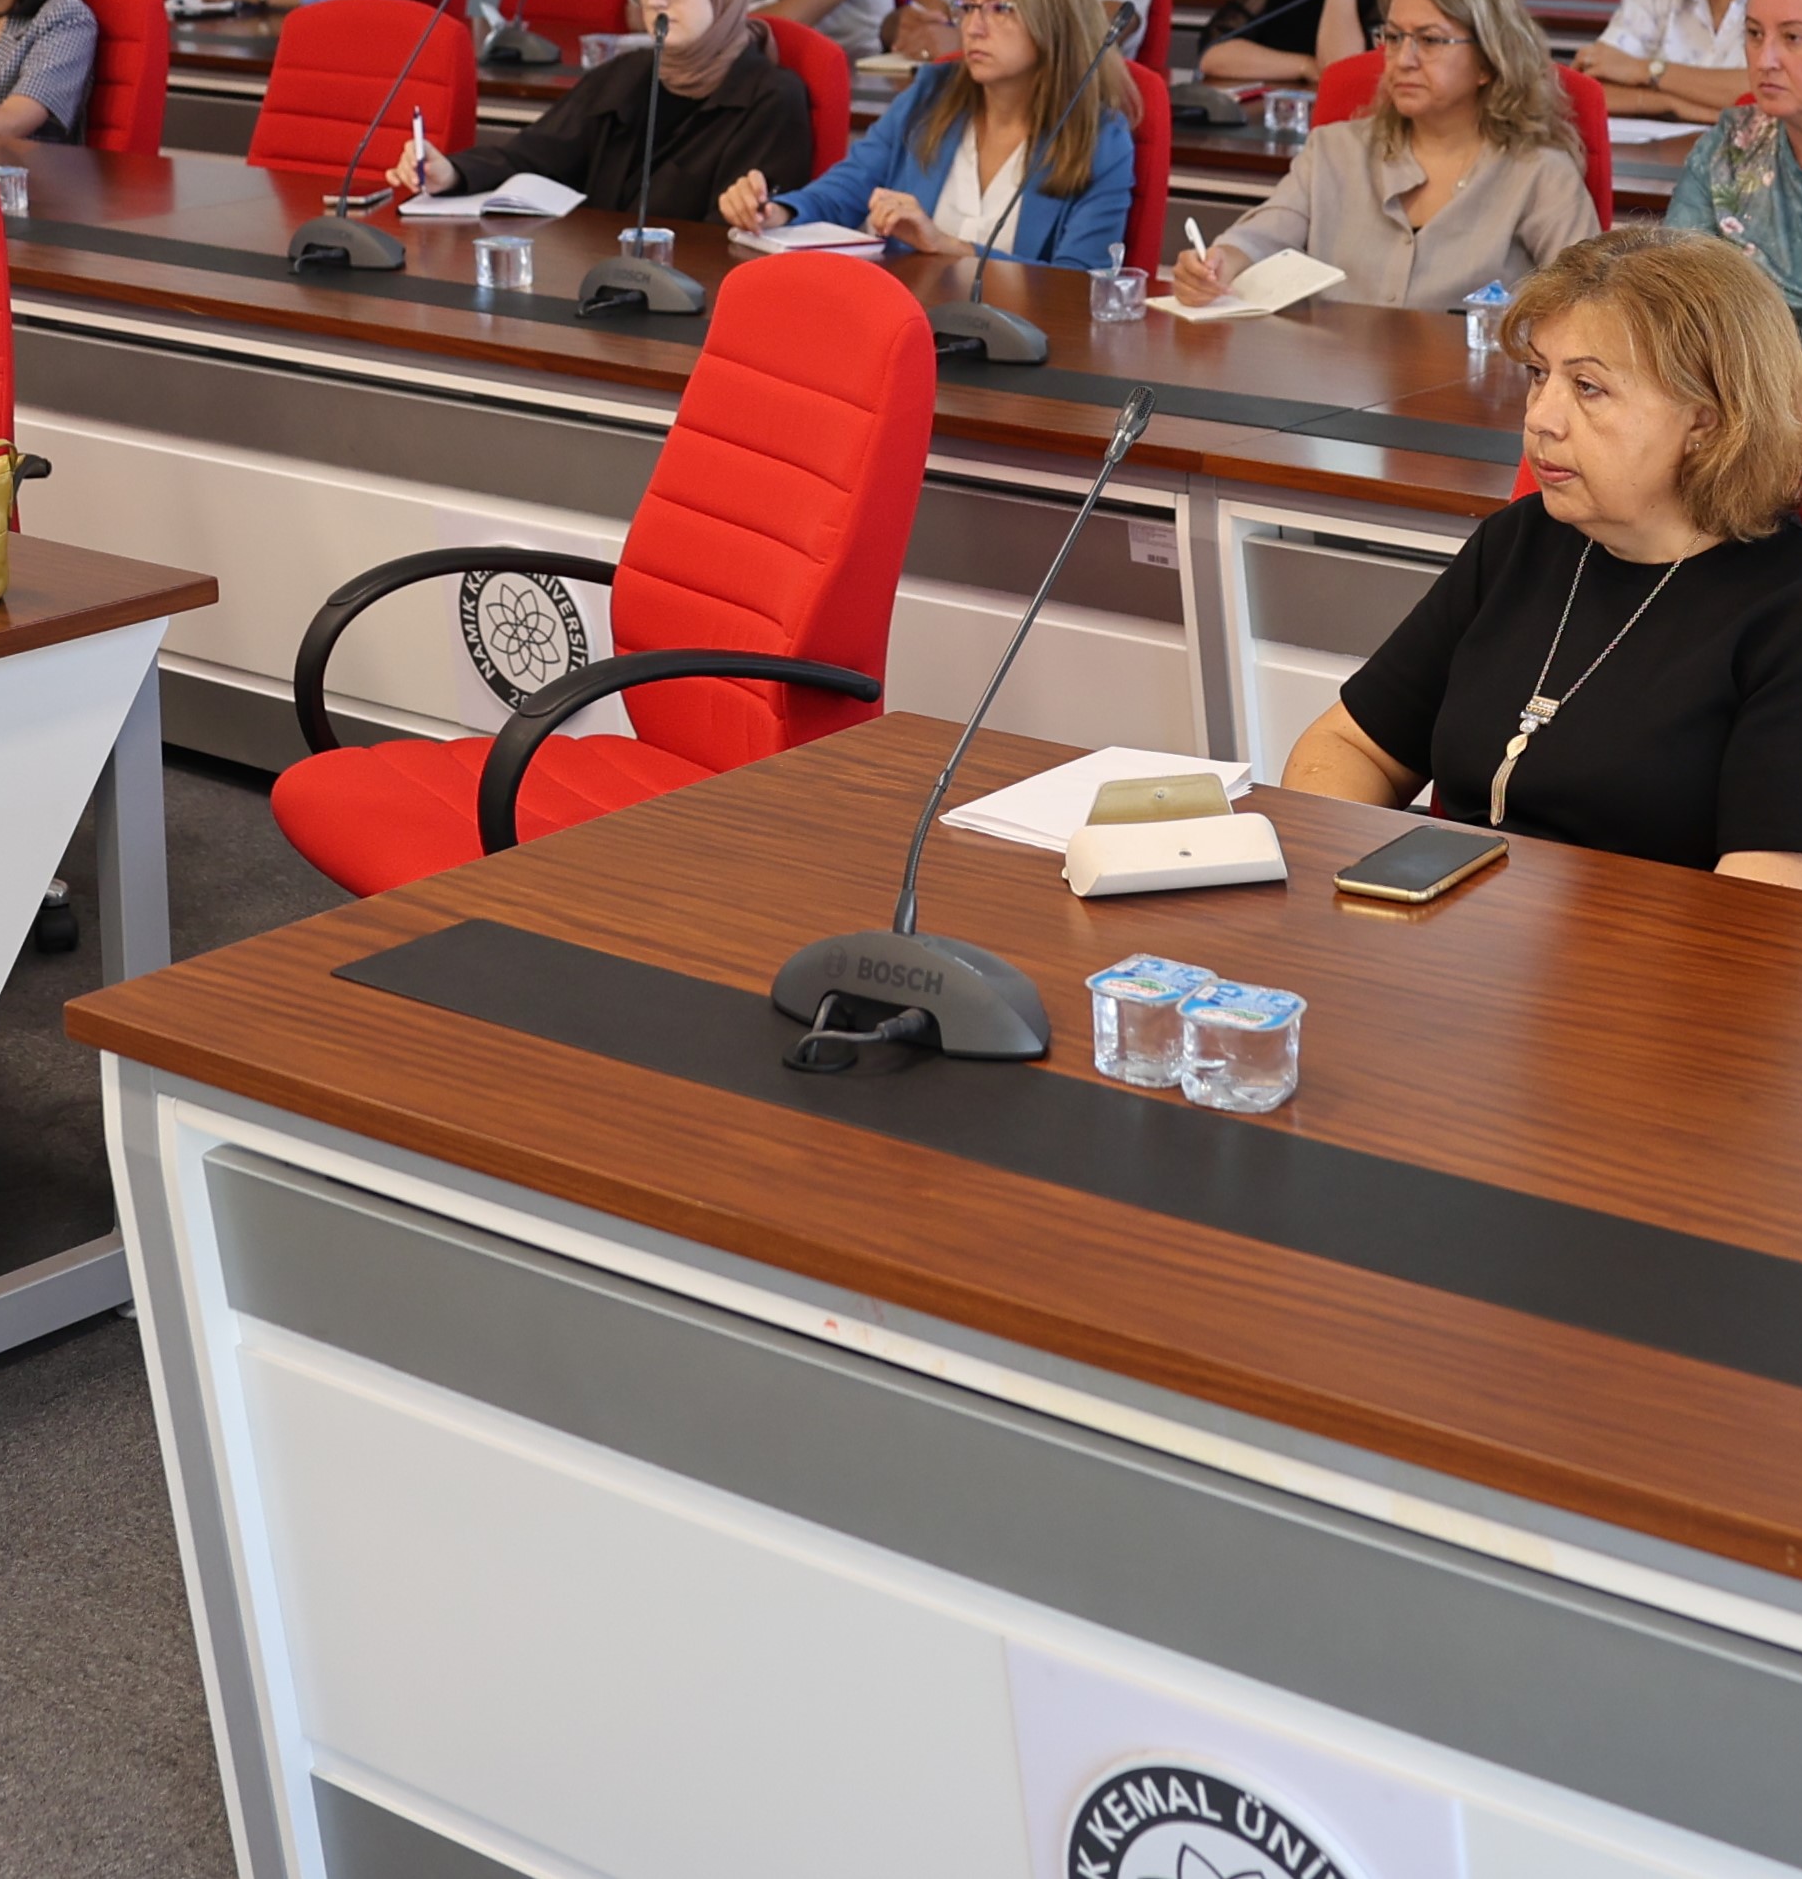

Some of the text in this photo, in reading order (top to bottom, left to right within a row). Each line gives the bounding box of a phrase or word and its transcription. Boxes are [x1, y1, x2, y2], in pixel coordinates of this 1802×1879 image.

[461, 595, 496, 680] NAMIK
[856, 954, 945, 997] BOSCH
[1085, 1775, 1223, 1852] KEMAL
